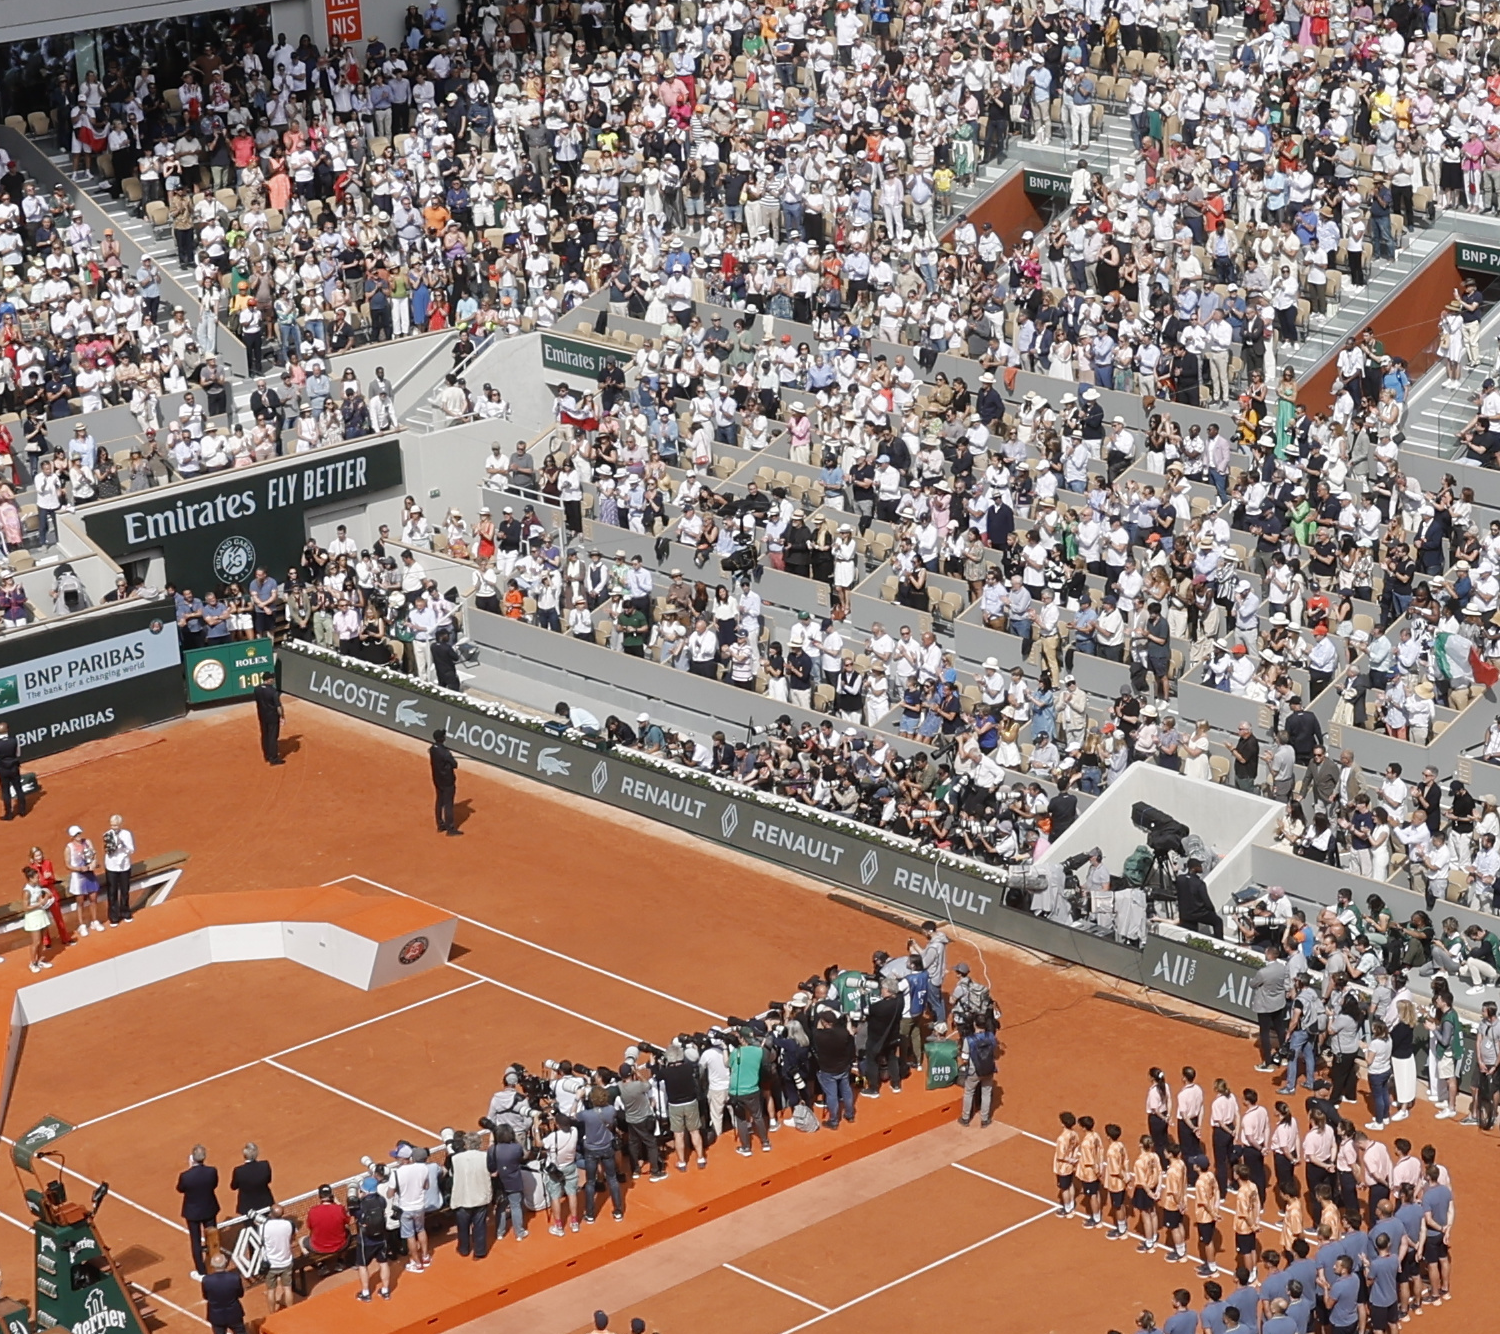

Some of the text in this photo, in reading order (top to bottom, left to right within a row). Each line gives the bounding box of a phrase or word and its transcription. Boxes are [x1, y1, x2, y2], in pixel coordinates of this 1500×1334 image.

[332, 15, 357, 35] NIS
[1029, 176, 1051, 190] BNP
[1462, 248, 1488, 264] BNP
[544, 343, 595, 370] Emirates
[123, 456, 367, 544] Emirates FLY BETTER
[215, 540, 233, 570] ROLAND
[24, 642, 145, 690] BNP PARIBAS
[26, 689, 41, 700] The
[43, 683, 63, 696] bank
[85, 668, 122, 684] changing
[122, 660, 146, 674] world
[235, 655, 269, 668] ROLEX
[239, 672, 264, 689] 1:0
[309, 670, 390, 716] LACOSTE
[15, 707, 115, 748] BNP PARIBAS
[445, 715, 531, 764] LACOSTE
[621, 776, 706, 819] RENAULT
[752, 819, 844, 866] RENAULT
[893, 867, 992, 915] RENAULT
[1151, 951, 1190, 987] All
[931, 1066, 951, 1075] RHB
